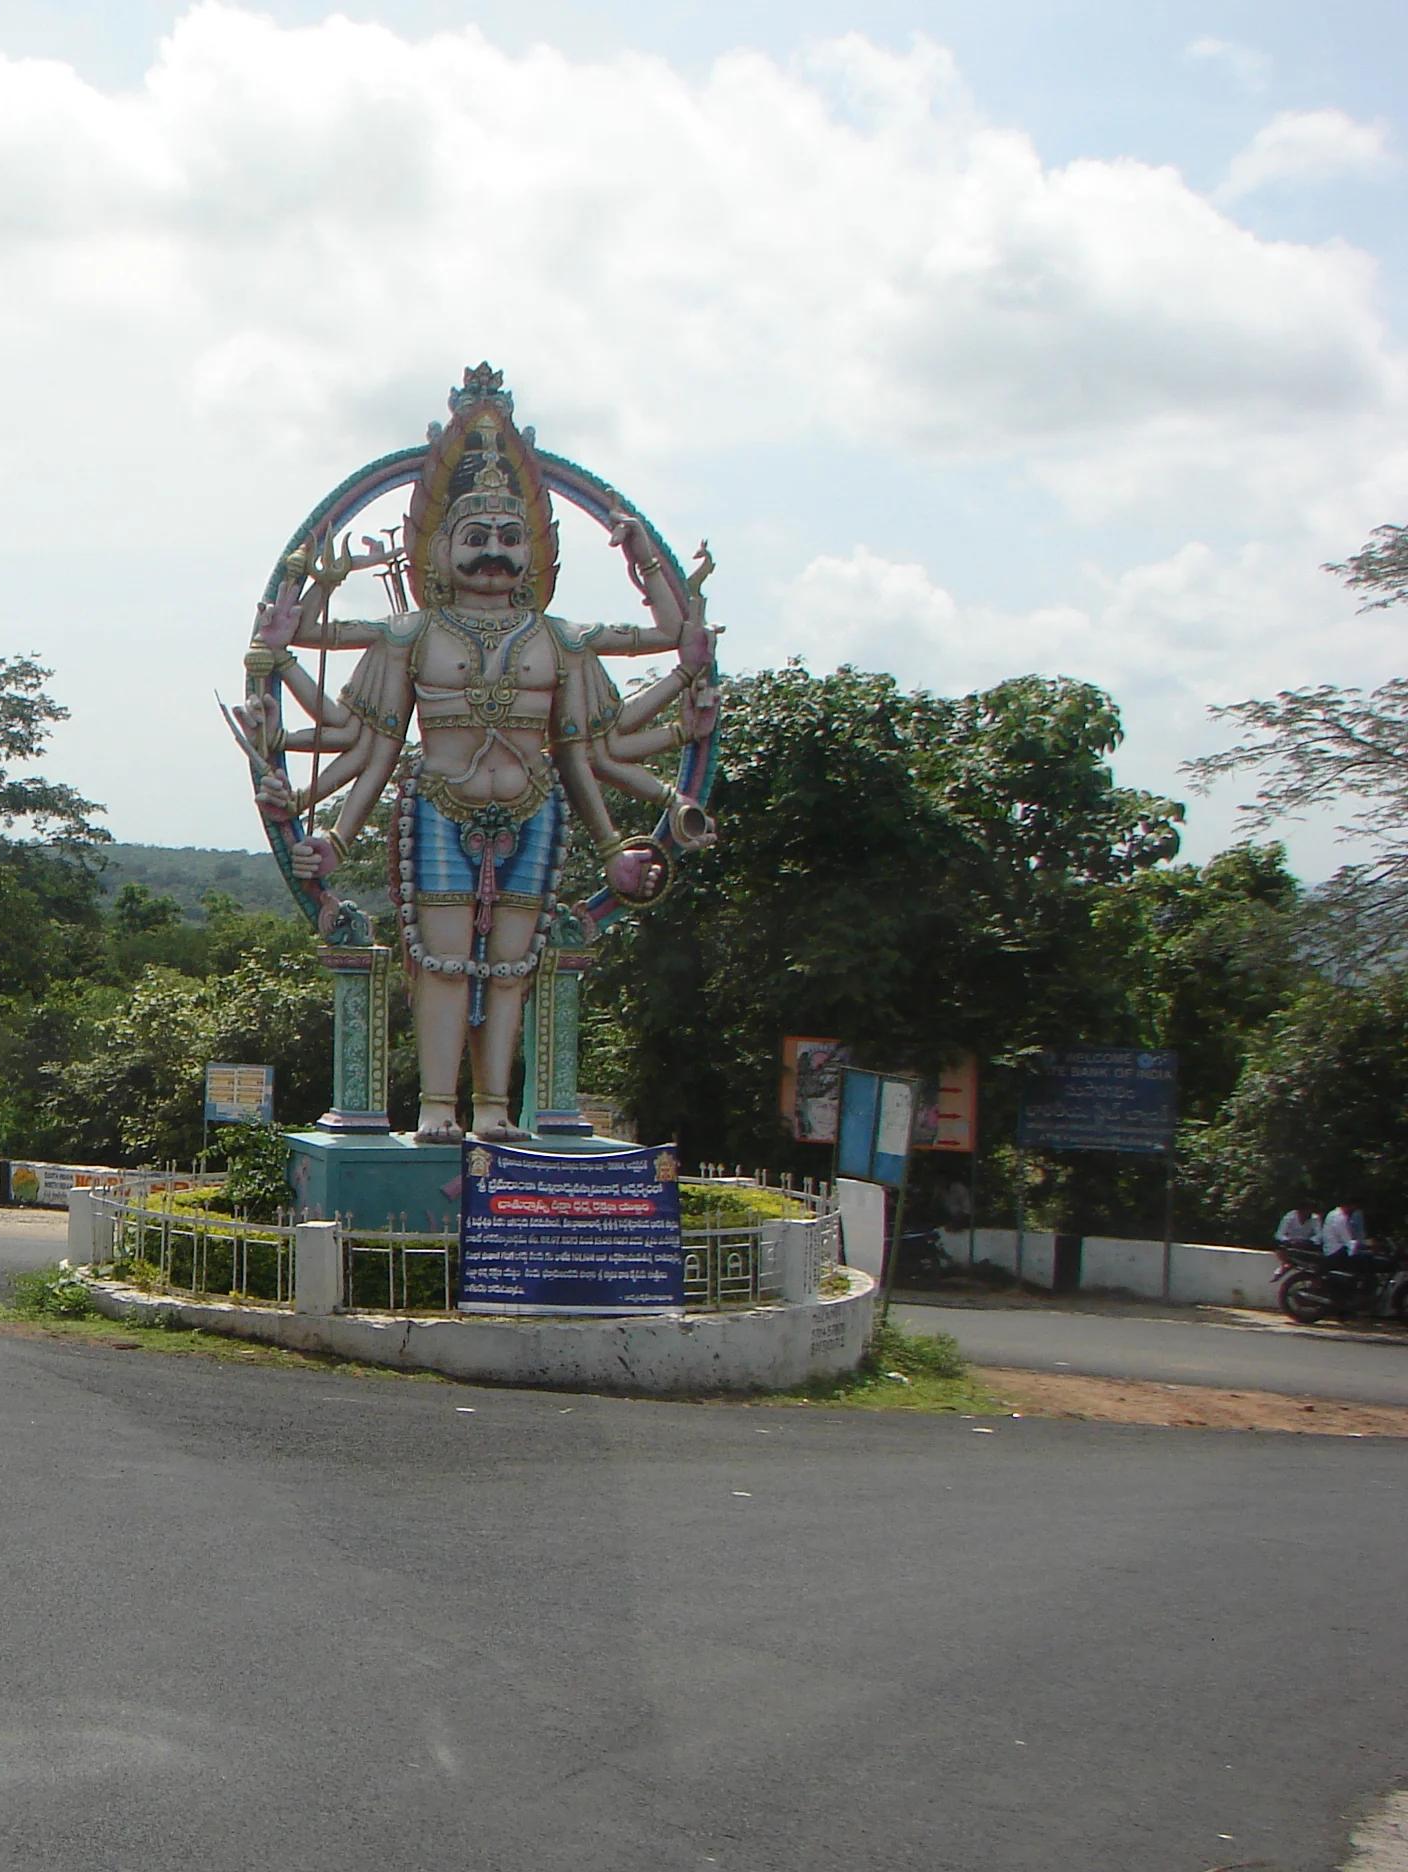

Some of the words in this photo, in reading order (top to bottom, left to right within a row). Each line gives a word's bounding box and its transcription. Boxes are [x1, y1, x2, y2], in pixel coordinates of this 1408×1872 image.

[1066, 1052, 1133, 1064] WELCOME
[1071, 1066, 1108, 1078] BANK
[1113, 1067, 1134, 1079] OF
[1136, 1068, 1173, 1080] INDIA
